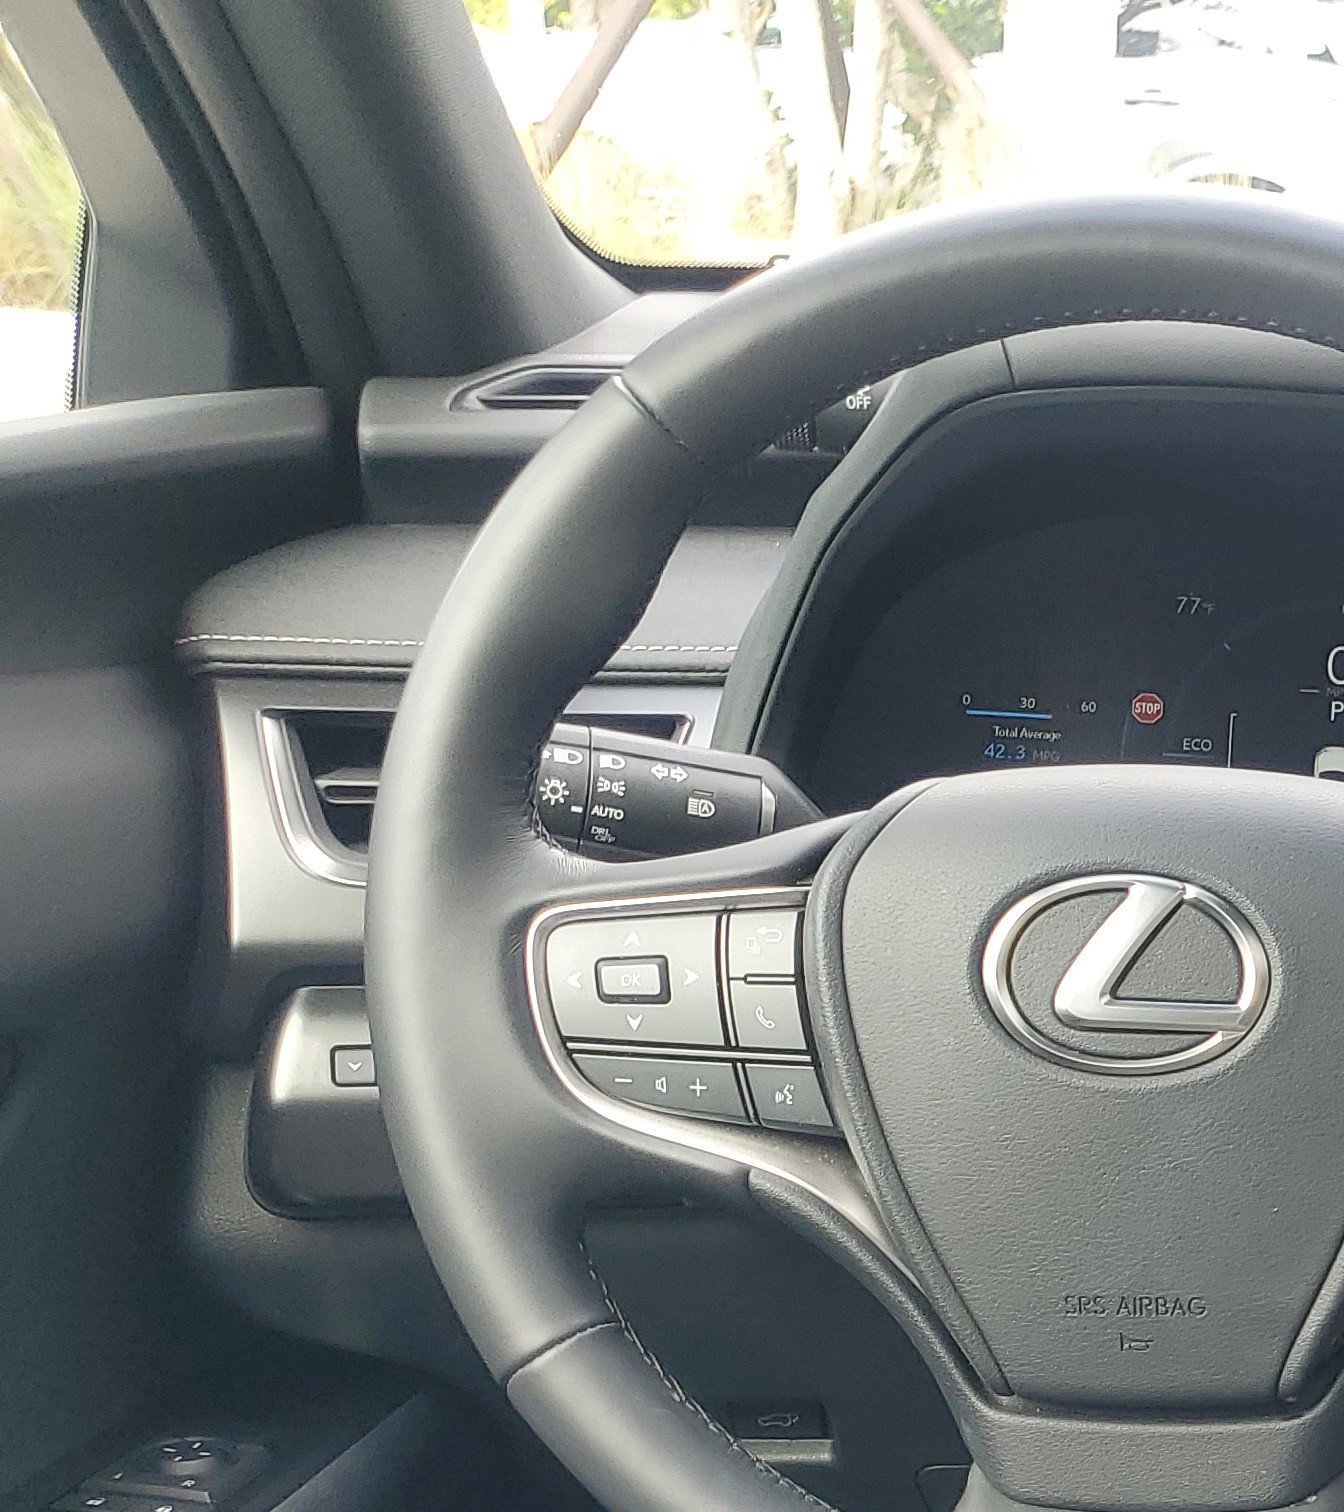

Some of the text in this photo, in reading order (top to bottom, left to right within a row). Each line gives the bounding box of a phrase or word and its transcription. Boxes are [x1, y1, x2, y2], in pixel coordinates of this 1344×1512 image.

[845, 396, 872, 410] OFF
[962, 693, 1097, 713] 0 30 60
[1134, 701, 1161, 716] STOP
[1330, 700, 1344, 722] P
[992, 725, 1062, 743] Total Average
[983, 743, 1060, 762] 42.3 MPG
[1183, 737, 1212, 752] ECO
[590, 804, 625, 821] AUTO
[590, 825, 609, 836] DRL
[619, 972, 642, 988] OK
[1064, 1294, 1209, 1319] SRS AIRBAG
